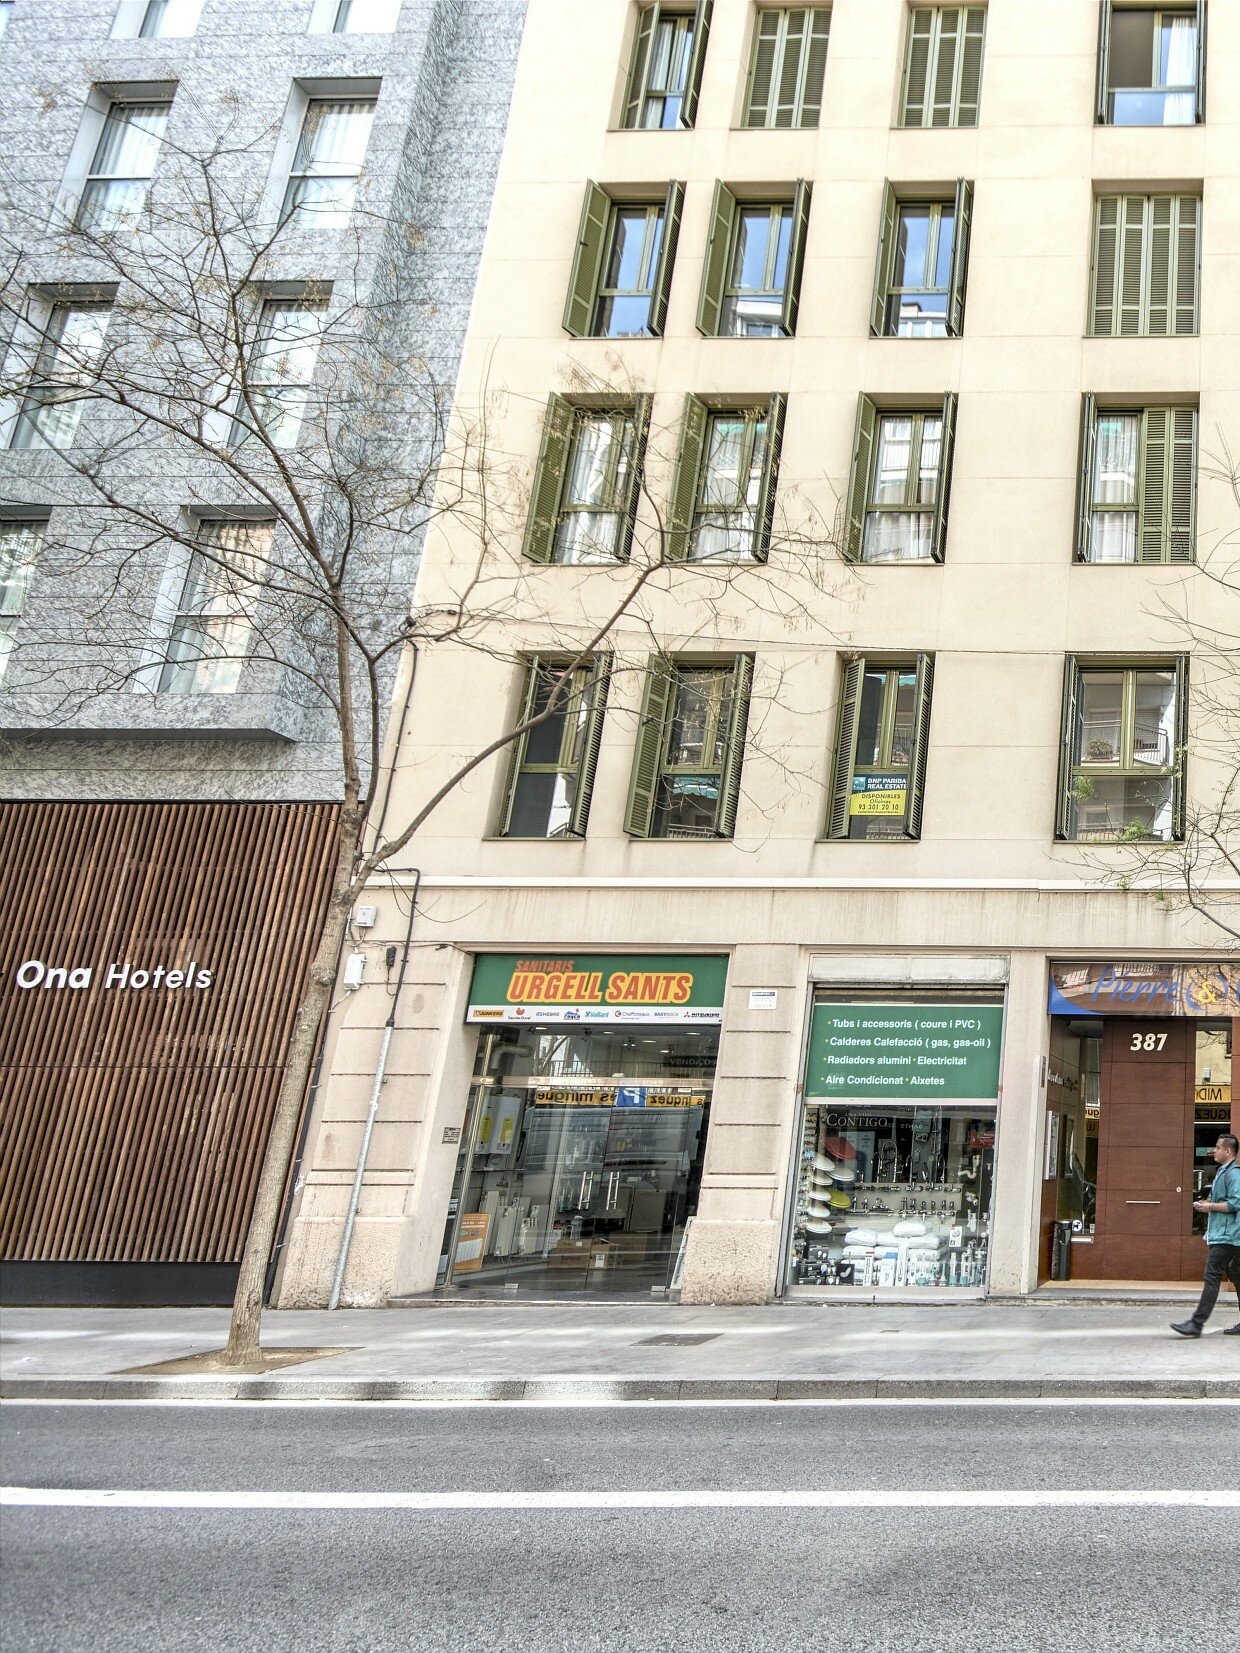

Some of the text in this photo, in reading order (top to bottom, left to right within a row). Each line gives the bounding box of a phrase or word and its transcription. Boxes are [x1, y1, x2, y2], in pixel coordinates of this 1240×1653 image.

[515, 960, 575, 972] SANITARIS
[16, 960, 213, 989] Ona Hotels
[508, 973, 692, 1002] URGELL SANTS
[1090, 965, 1179, 1003] Pierre
[1197, 980, 1218, 1004] &
[832, 1019, 855, 1028] Tubs
[856, 1019, 860, 1028] i
[862, 1019, 912, 1028] accessoris
[955, 1020, 976, 1028] PVC
[829, 1037, 872, 1046] Calderes
[873, 1037, 923, 1046] Calefacció
[931, 1039, 951, 1048] gas,
[953, 1038, 985, 1048] gas-oil
[1130, 1033, 1168, 1051] 387
[827, 1056, 967, 1065] Radiadors alumini Electricitat
[825, 1075, 945, 1085] Aire Condicionat Aixetes
[826, 1113, 888, 1127] CONTIGO
